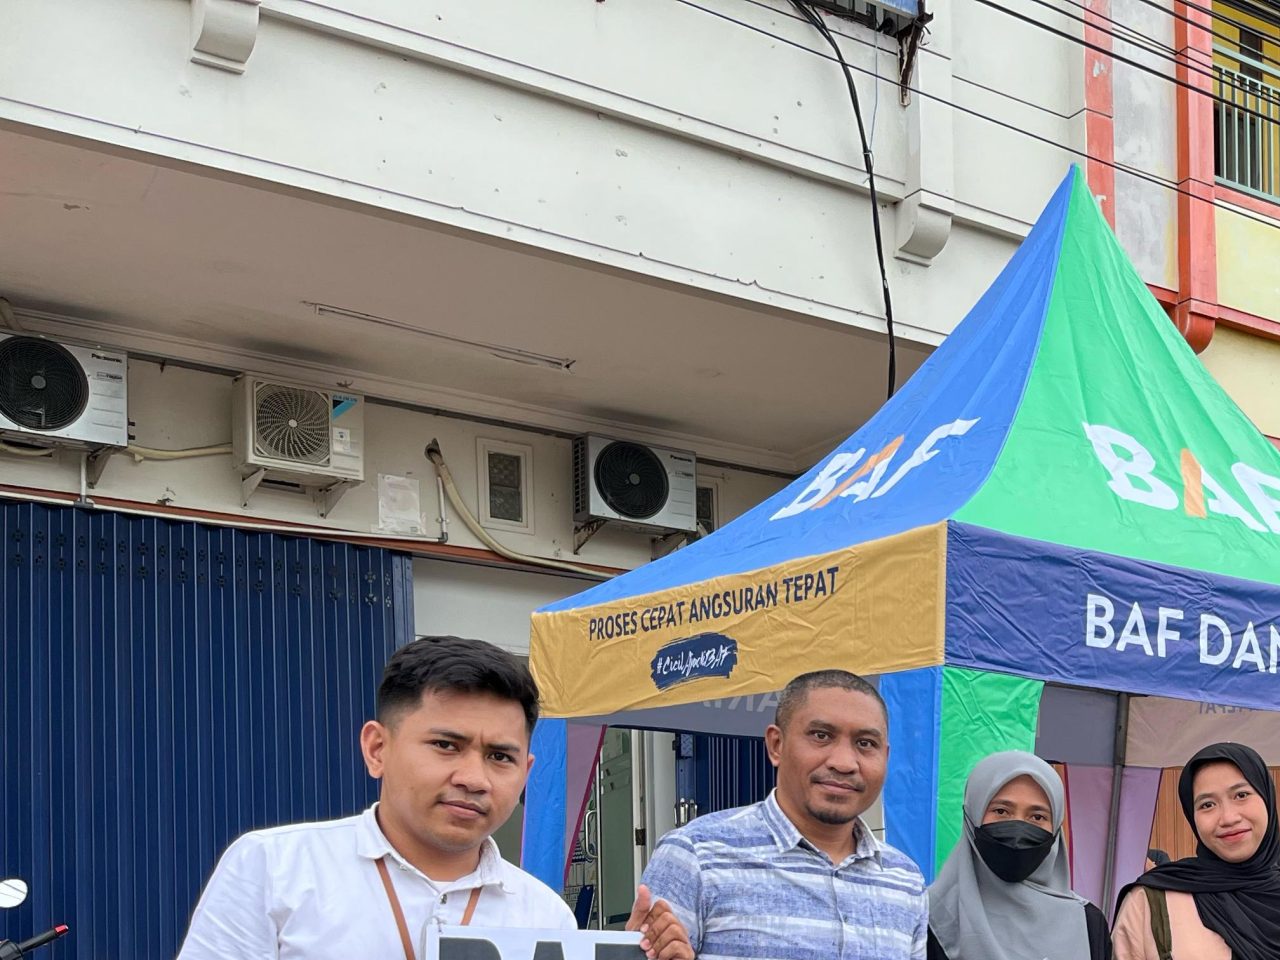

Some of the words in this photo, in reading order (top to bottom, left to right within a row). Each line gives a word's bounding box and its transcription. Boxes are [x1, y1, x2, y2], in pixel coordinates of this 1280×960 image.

[769, 417, 981, 521] BAF
[589, 611, 637, 641] PROSES
[641, 601, 685, 632] CEPAT
[689, 581, 778, 623] ANGSURAN
[783, 566, 839, 603] TEPAT
[1086, 593, 1184, 658] BAF
